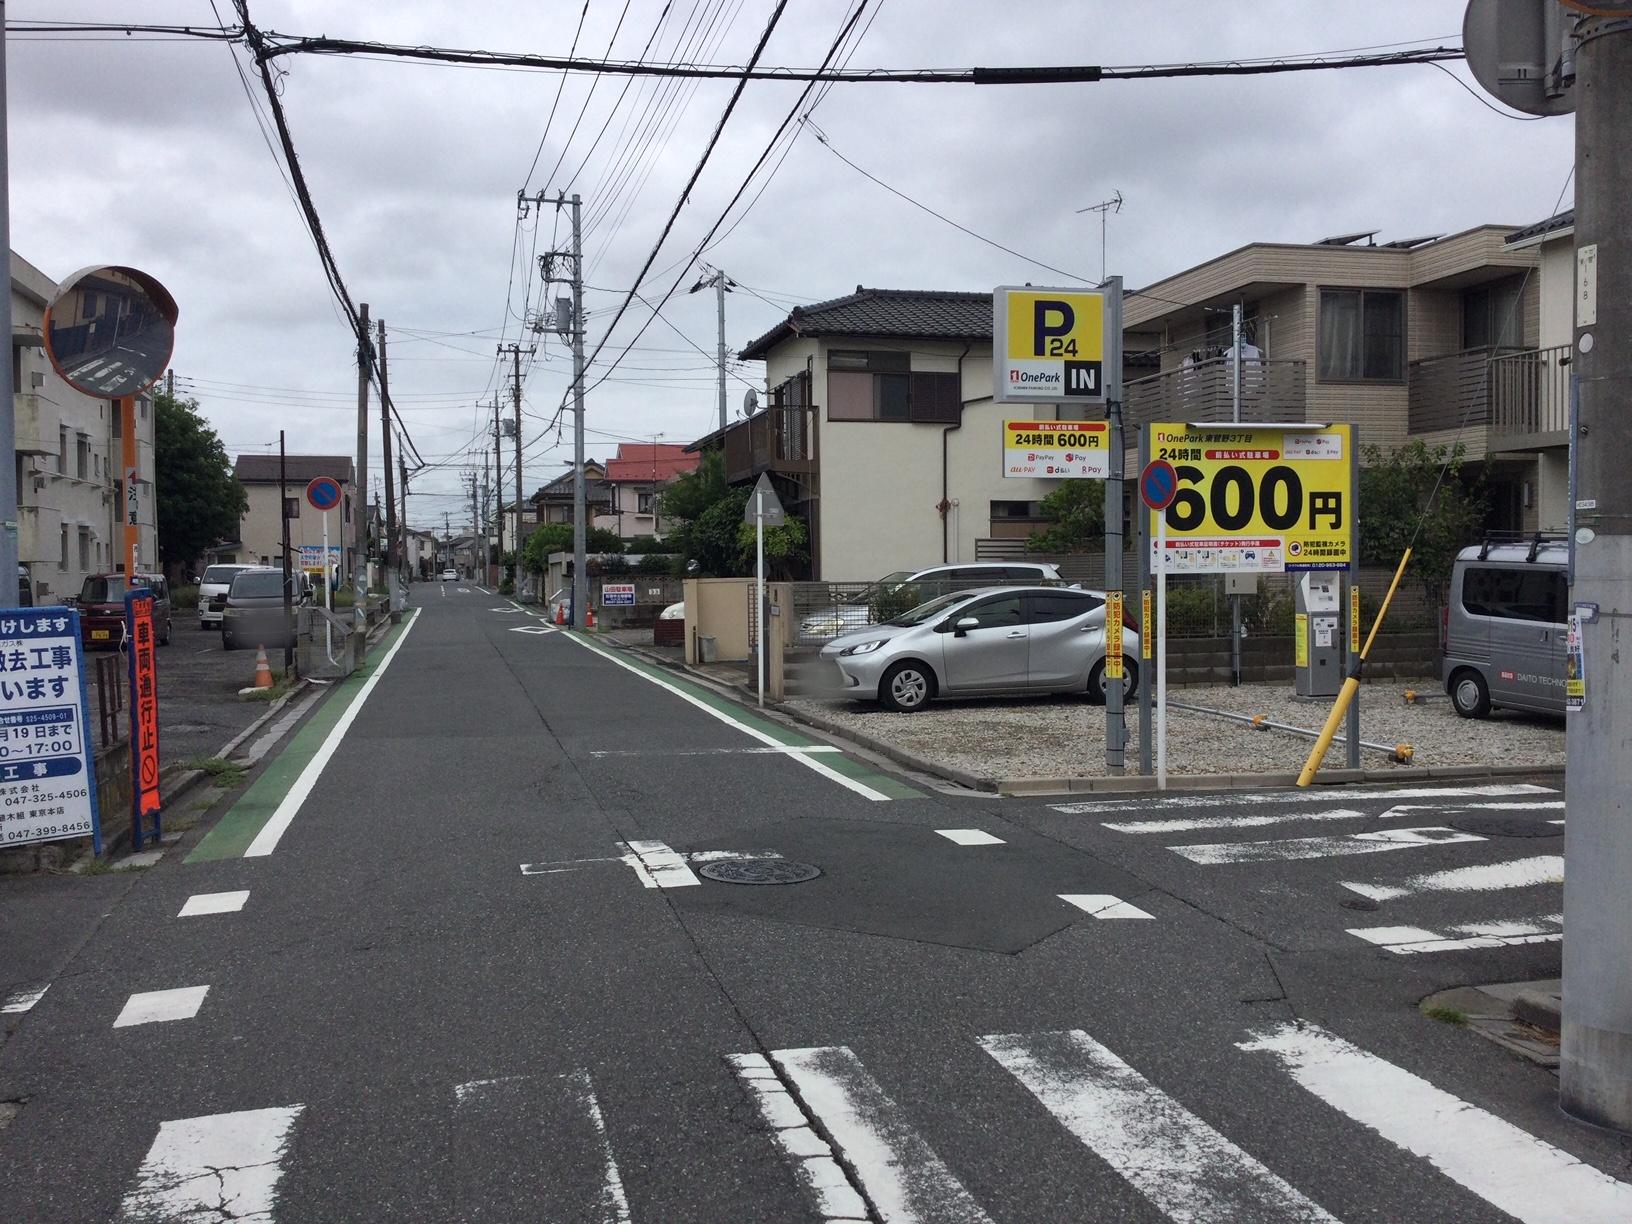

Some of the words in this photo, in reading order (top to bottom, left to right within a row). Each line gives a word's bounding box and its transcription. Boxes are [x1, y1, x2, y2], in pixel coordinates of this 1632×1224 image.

[1034, 300, 1075, 357] P
[1050, 338, 1079, 357] 24
[1020, 371, 1061, 382] OnePark
[1071, 368, 1095, 390] IN
[1015, 433, 1054, 446] 24時間
[1057, 433, 1099, 447] 600円
[1166, 433, 1203, 443] OnePark
[1159, 448, 1202, 461] 24時間
[5, 789, 87, 806] 047-325-4506
[8, 821, 90, 840] 047-399-8456
